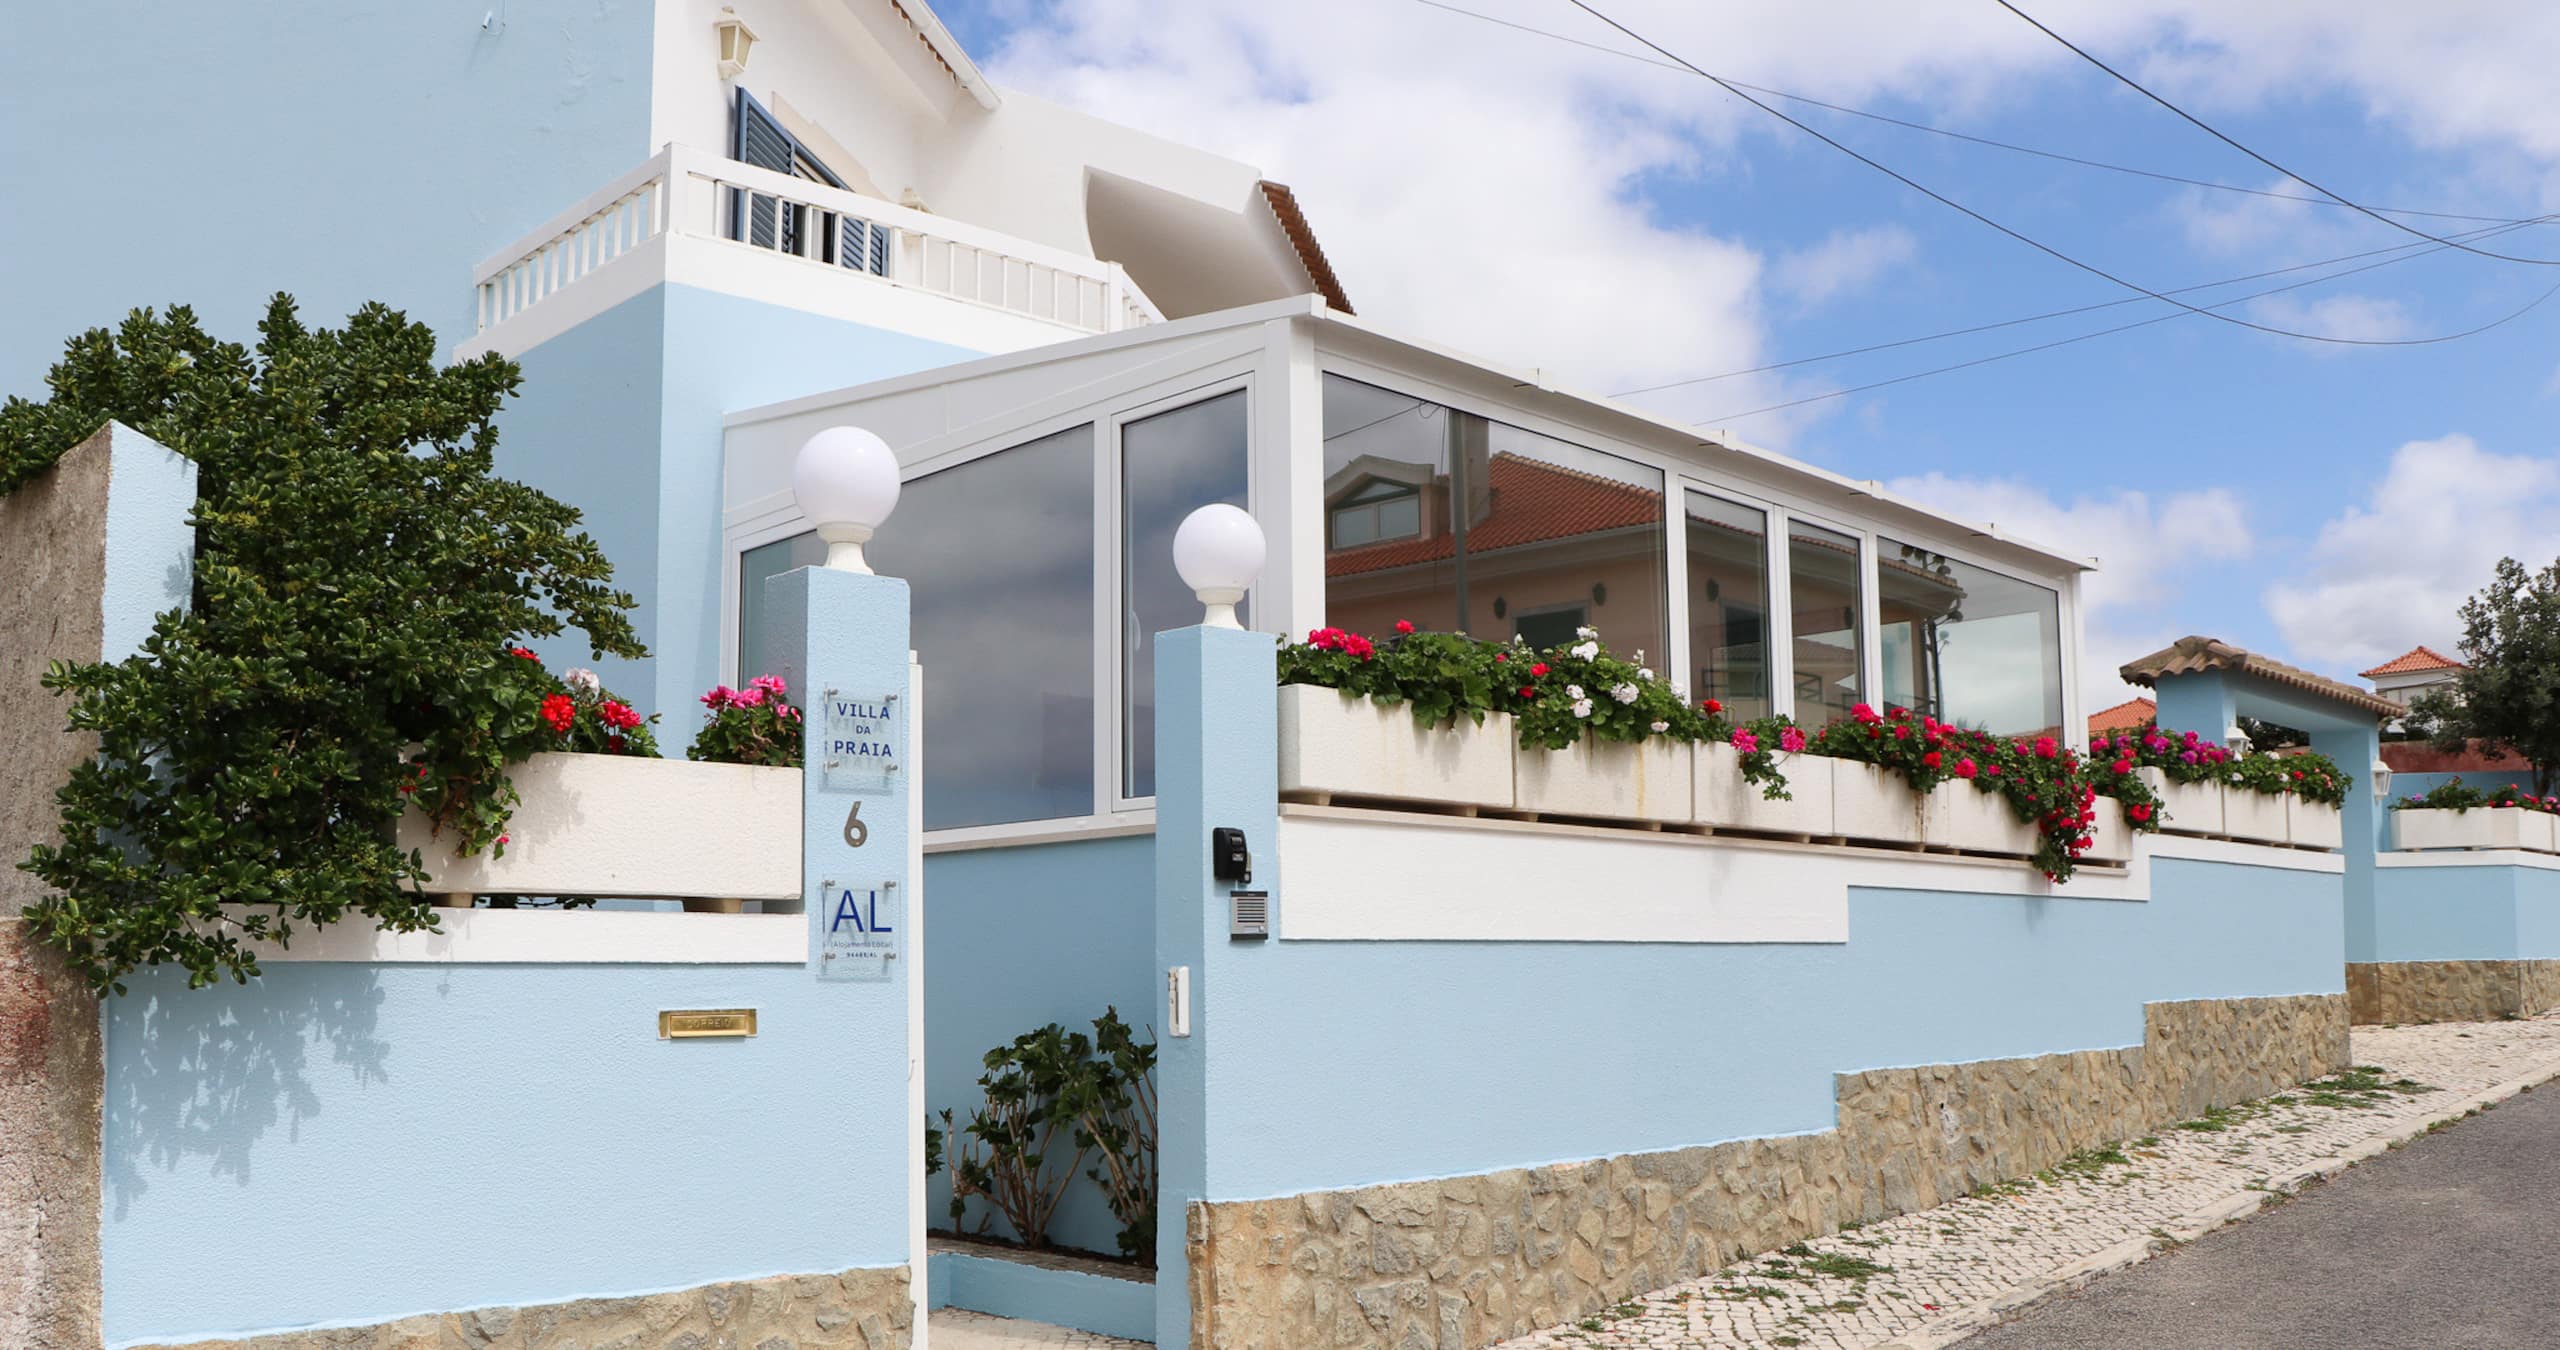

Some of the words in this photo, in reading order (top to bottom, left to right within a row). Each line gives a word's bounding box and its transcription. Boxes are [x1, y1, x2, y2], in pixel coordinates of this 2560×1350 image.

[837, 702, 890, 720] VILLA
[856, 725, 871, 735] DA
[834, 740, 892, 757] PRAIA
[844, 800, 868, 848] 6
[832, 890, 892, 932] AL
